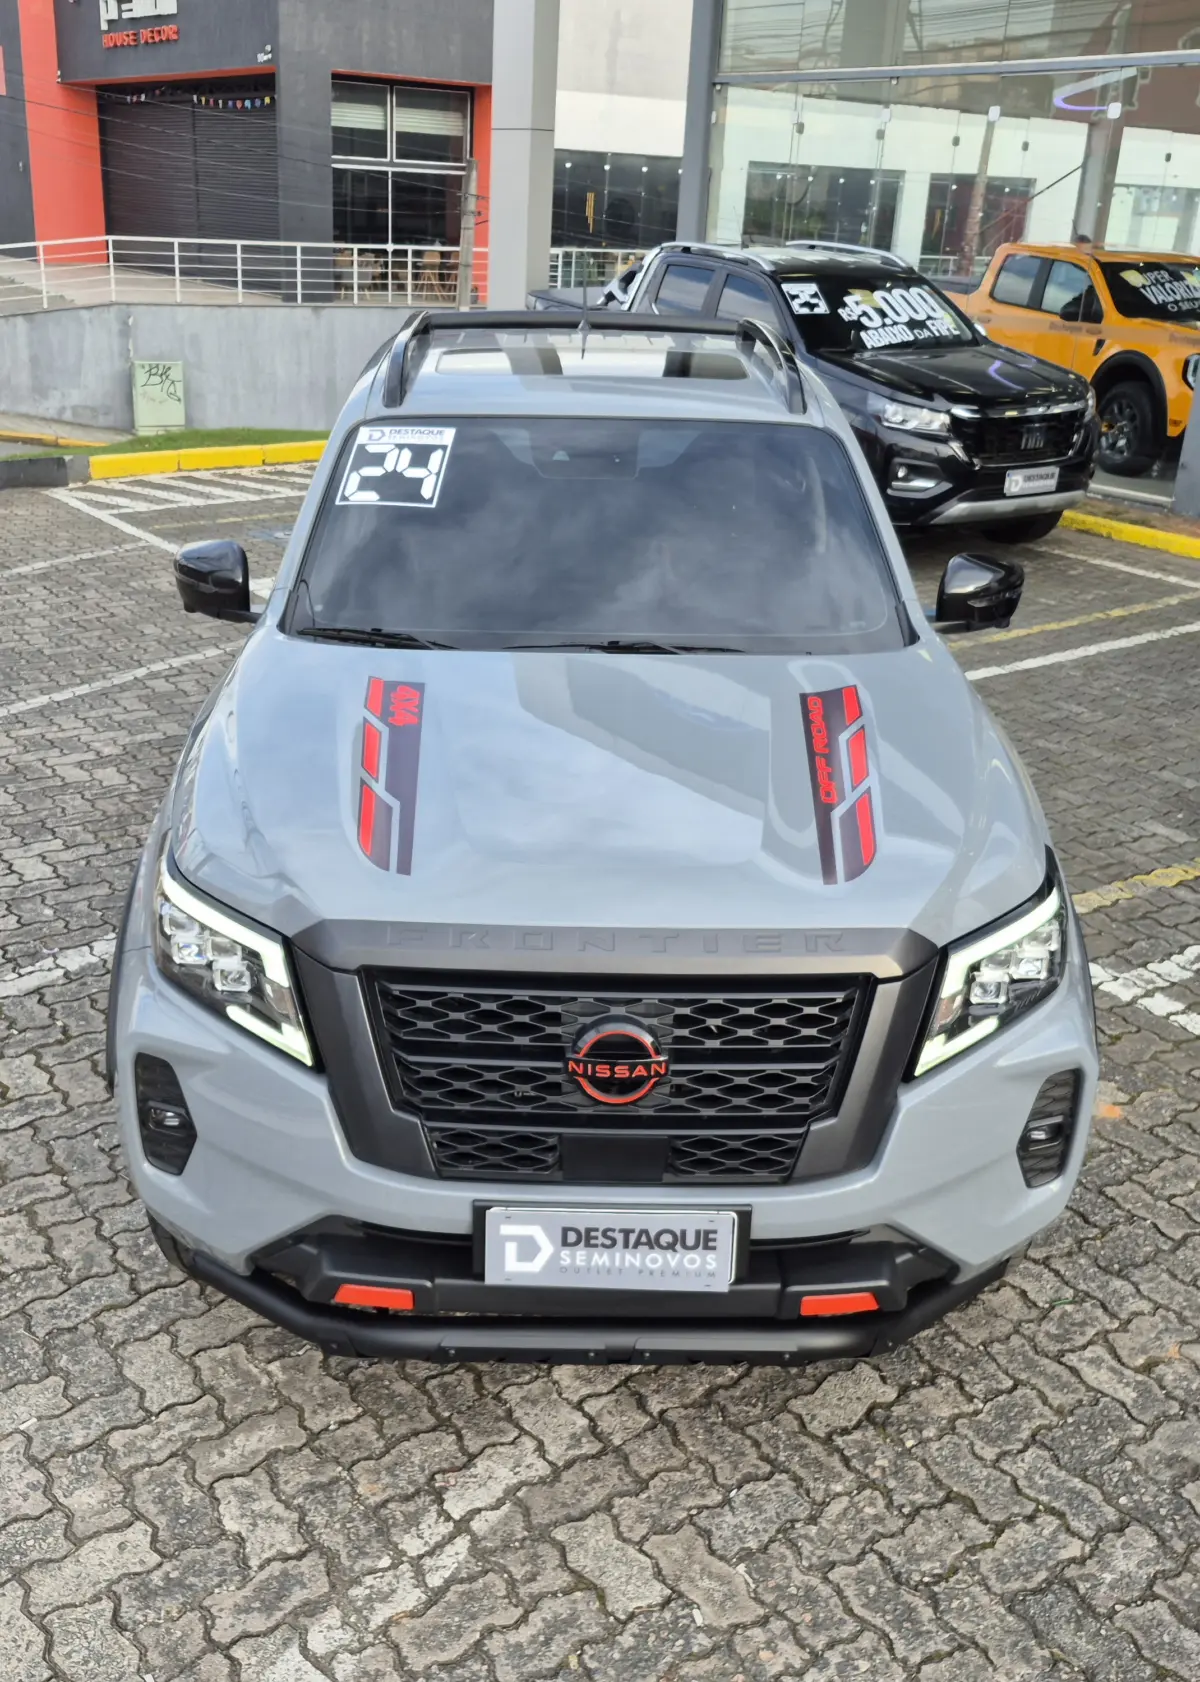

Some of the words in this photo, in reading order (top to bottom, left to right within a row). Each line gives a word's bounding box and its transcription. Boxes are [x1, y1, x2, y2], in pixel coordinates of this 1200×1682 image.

[102, 31, 138, 48] HOUSE
[140, 25, 178, 44] DECOR
[1168, 303, 1178, 312] O
[860, 325, 914, 349] ABAIXO
[914, 330, 933, 339] DA
[925, 319, 961, 338] FIPE
[389, 428, 445, 436] DESTAQUE
[344, 444, 443, 501] 24
[808, 697, 829, 753] ROAD
[816, 756, 837, 803] OFF
[386, 926, 844, 953] FRONTIER
[568, 1061, 666, 1077] NISSAN
[561, 1226, 718, 1252] DESTAQUE
[559, 1250, 717, 1270] SEMINOVOS
[559, 1266, 623, 1275] OUTLET
[637, 1269, 716, 1279] PREMIUM
